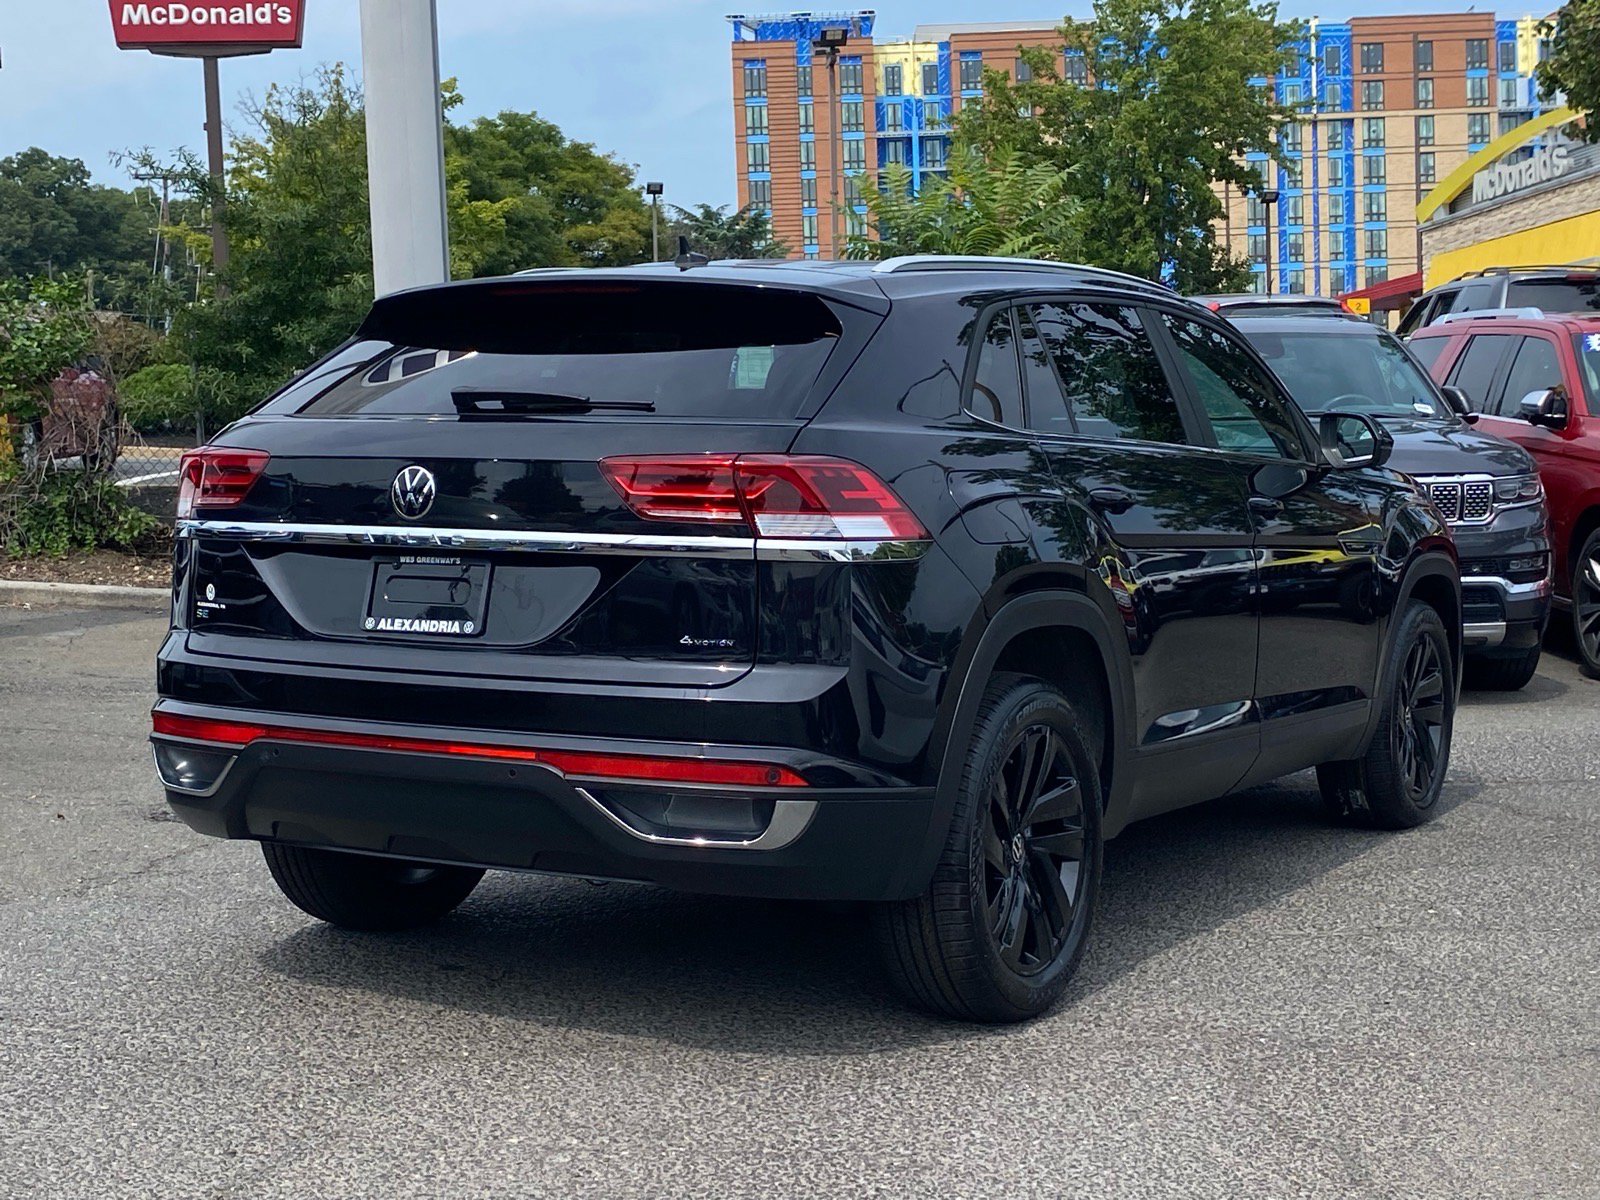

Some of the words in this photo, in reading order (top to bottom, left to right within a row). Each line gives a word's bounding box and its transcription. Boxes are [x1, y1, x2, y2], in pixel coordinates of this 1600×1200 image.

[121, 3, 292, 26] McDonald's
[1355, 302, 1362, 311] 2
[399, 556, 415, 564] WES
[377, 618, 460, 633] ALEXANDRIA
